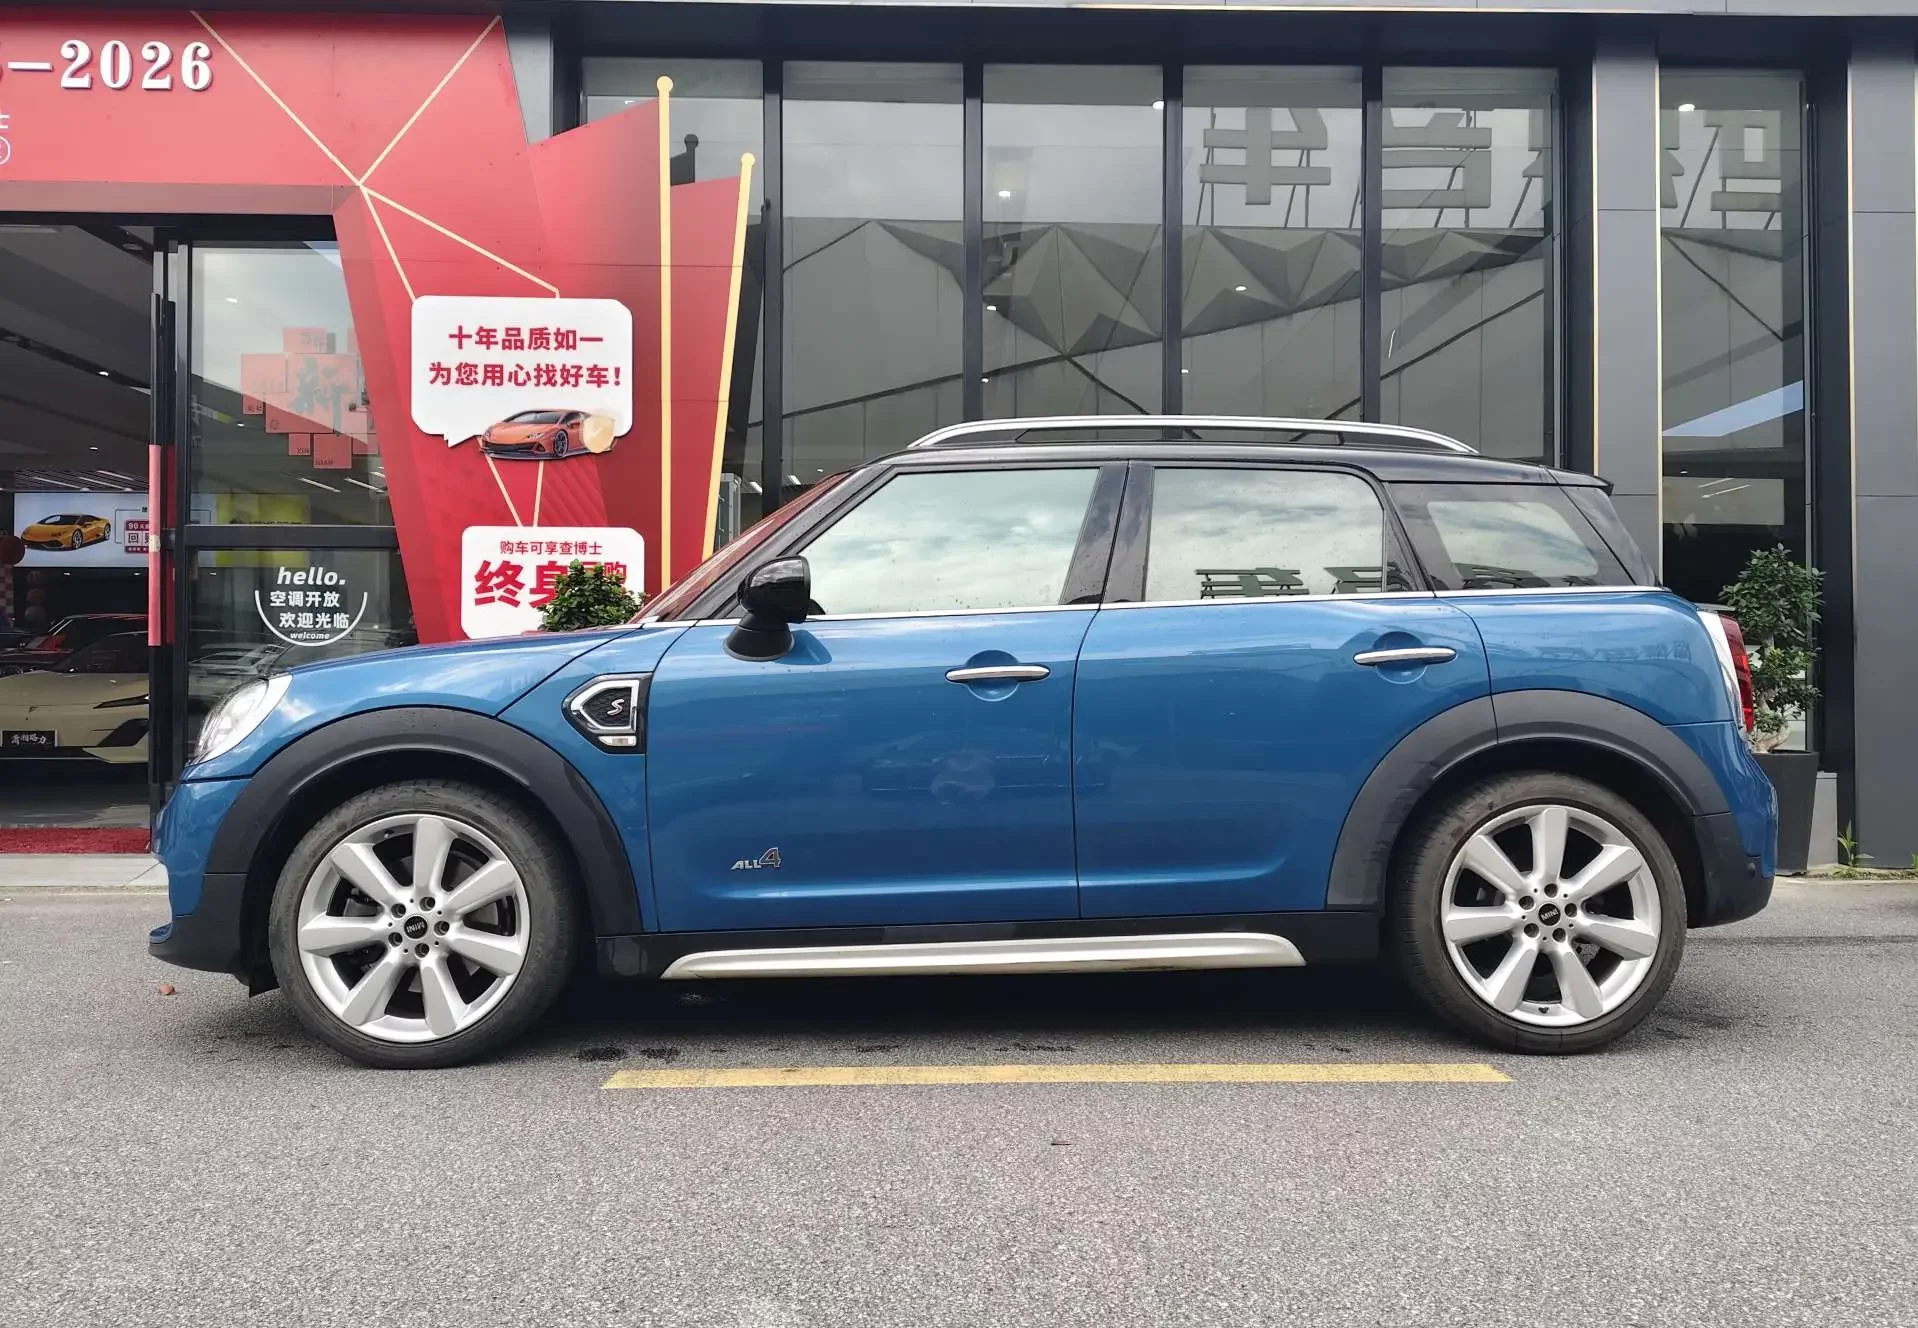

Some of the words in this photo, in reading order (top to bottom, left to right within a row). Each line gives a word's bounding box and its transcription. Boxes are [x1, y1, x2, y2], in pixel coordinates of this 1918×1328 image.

[448, 325, 604, 351] 十年品质如一
[429, 361, 621, 388] 为您用心找好车!
[500, 541, 603, 555] 购车可享查博士
[269, 590, 340, 608] 空调开放
[279, 612, 350, 629] 欢迎光临
[290, 631, 330, 640] welcome
[607, 698, 625, 716] S
